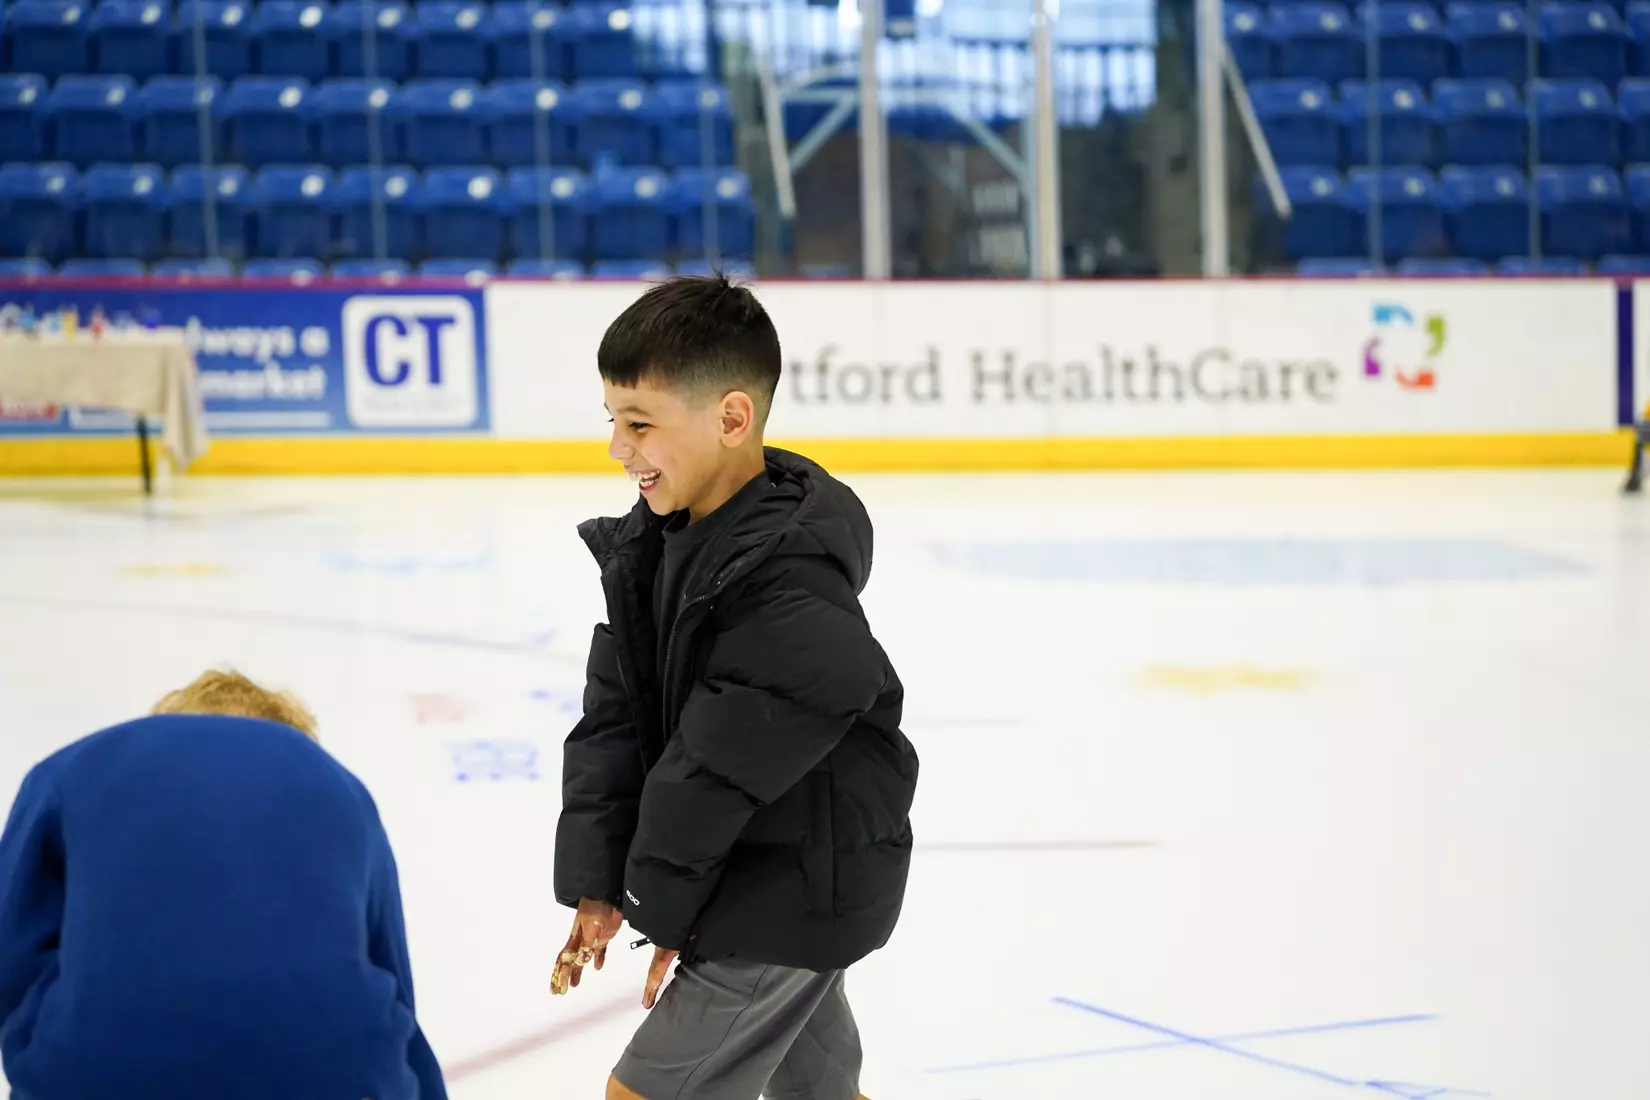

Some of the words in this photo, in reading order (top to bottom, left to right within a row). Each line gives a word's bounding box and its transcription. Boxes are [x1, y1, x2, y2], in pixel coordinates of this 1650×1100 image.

[364, 314, 455, 386] CT
[785, 345, 942, 403] tford
[971, 345, 1339, 402] HealthCare
